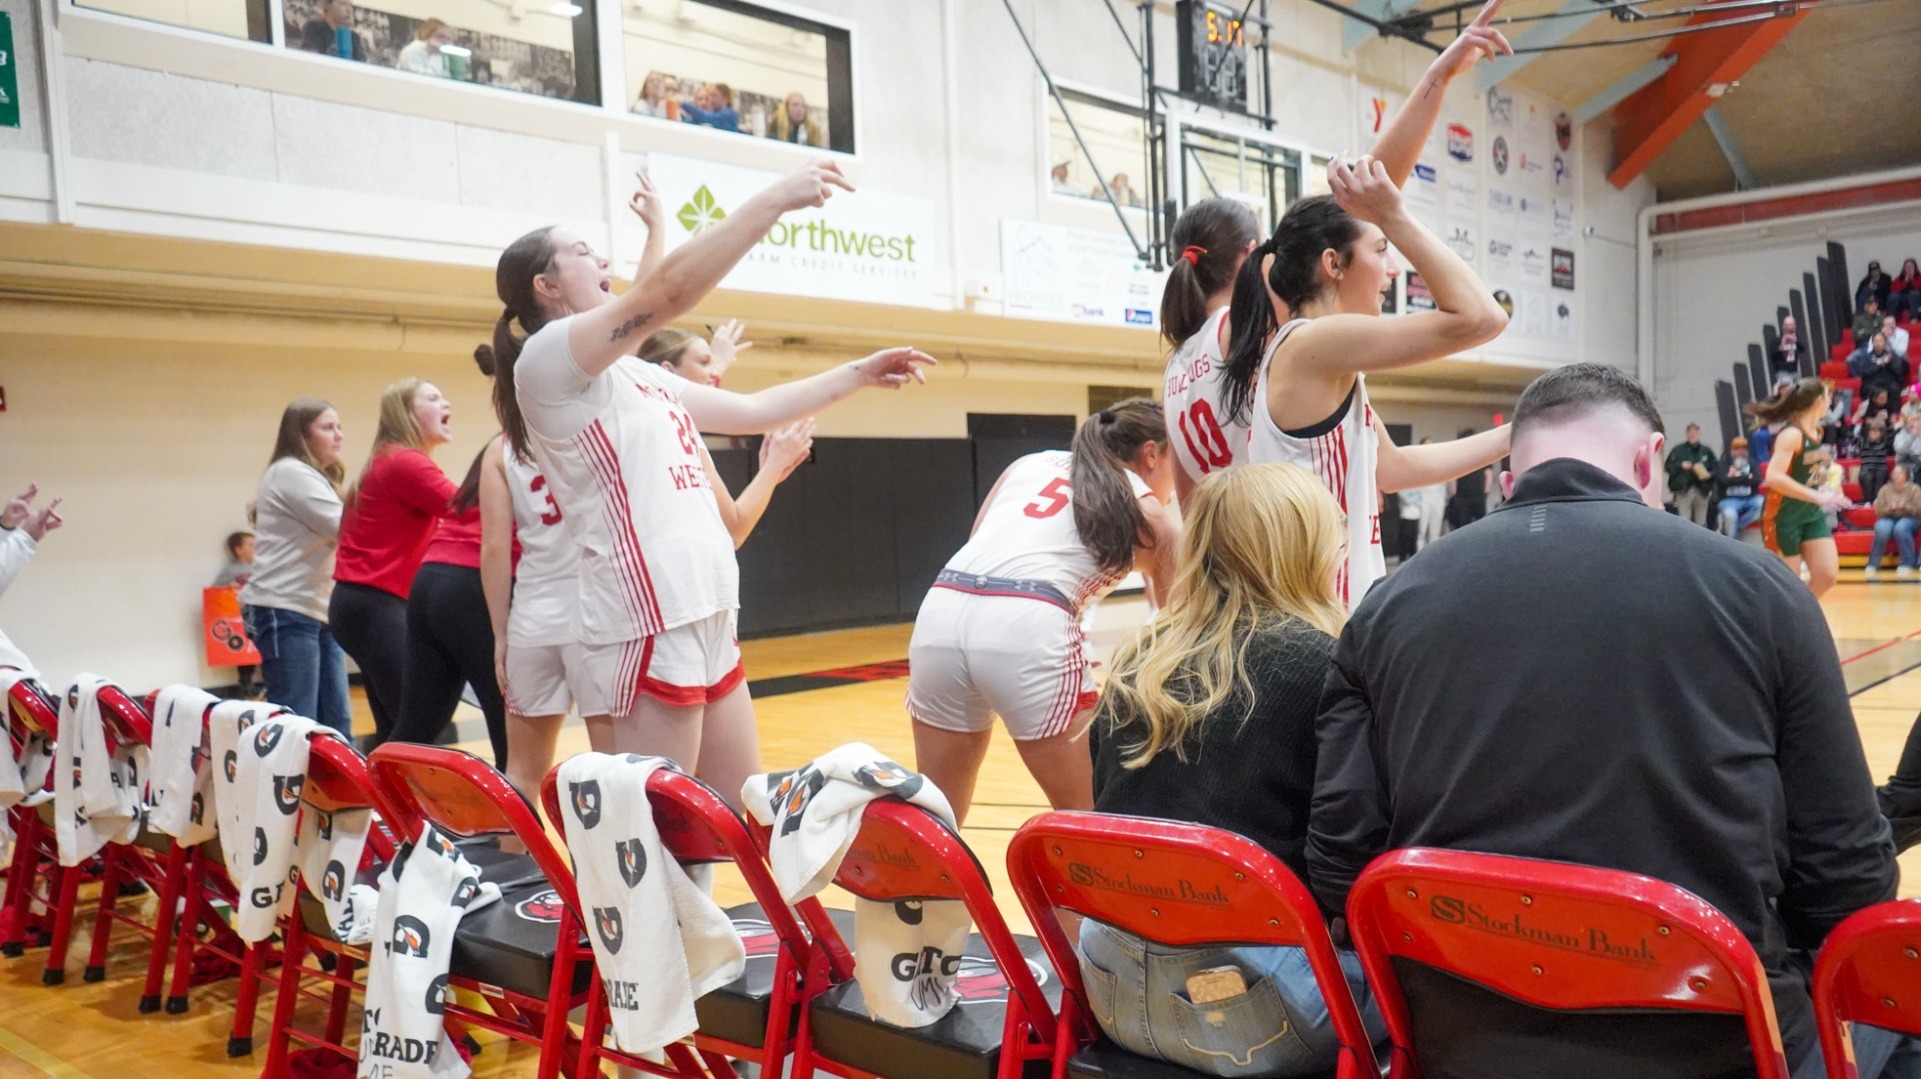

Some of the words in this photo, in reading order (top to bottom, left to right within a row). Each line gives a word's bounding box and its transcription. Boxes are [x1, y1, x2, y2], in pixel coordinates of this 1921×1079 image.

[757, 219, 916, 263] orthwest
[747, 251, 781, 266] ARM
[791, 255, 843, 273] CREDIT
[852, 261, 918, 281] SERVICES
[1168, 353, 1211, 398] ULOGS
[1179, 398, 1233, 474] 10
[530, 474, 563, 526] 3
[1023, 476, 1070, 519] 5
[1093, 867, 1175, 898] Stockman
[1177, 879, 1230, 903] Bank
[1466, 904, 1580, 949] Stockman
[1588, 928, 1657, 961] Bank
